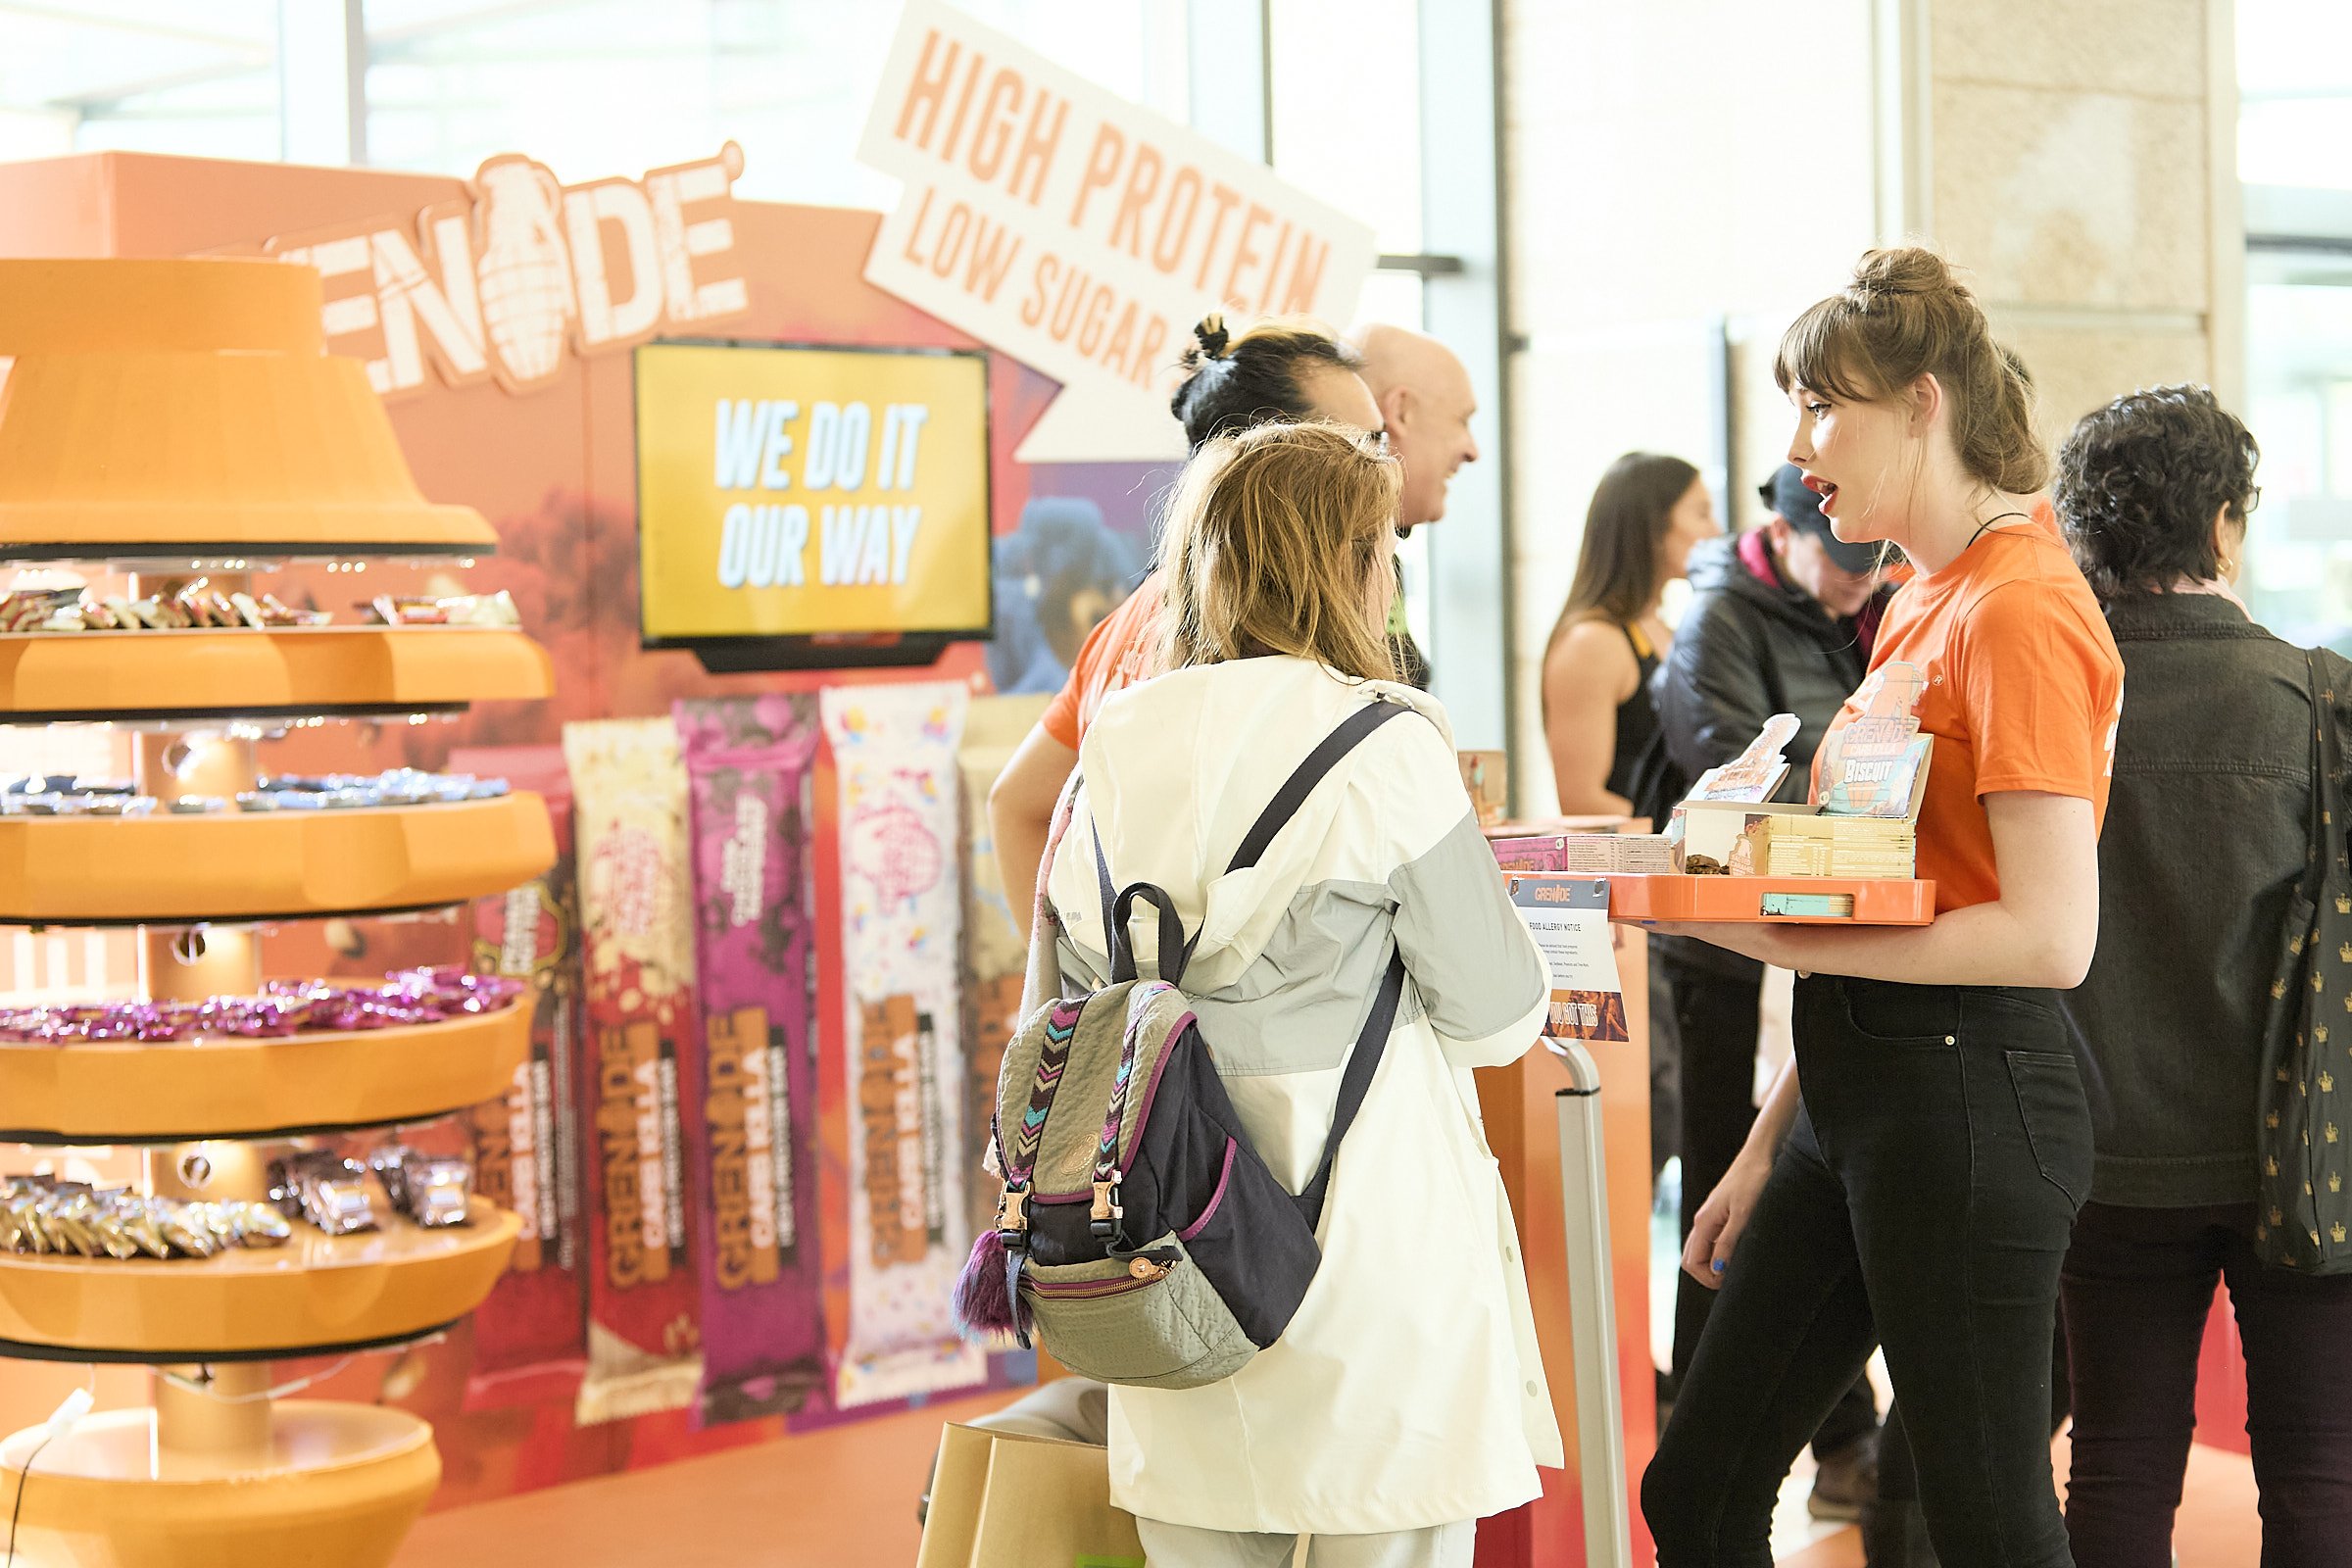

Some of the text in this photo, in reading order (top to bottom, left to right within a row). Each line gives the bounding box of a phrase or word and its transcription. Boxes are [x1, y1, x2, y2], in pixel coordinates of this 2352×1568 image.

[893, 27, 1332, 316] HIGH PROTEIN
[902, 185, 1181, 392] LOW SUGAR
[714, 399, 928, 491] WE DO IT
[717, 503, 921, 589] OUR WAY
[1843, 759, 1893, 784] BISCUIT
[1529, 921, 1581, 932] FOOD ALLERGY NOTICE
[1563, 1002, 1579, 1026] GOT
[1578, 1004, 1598, 1027] THIS
